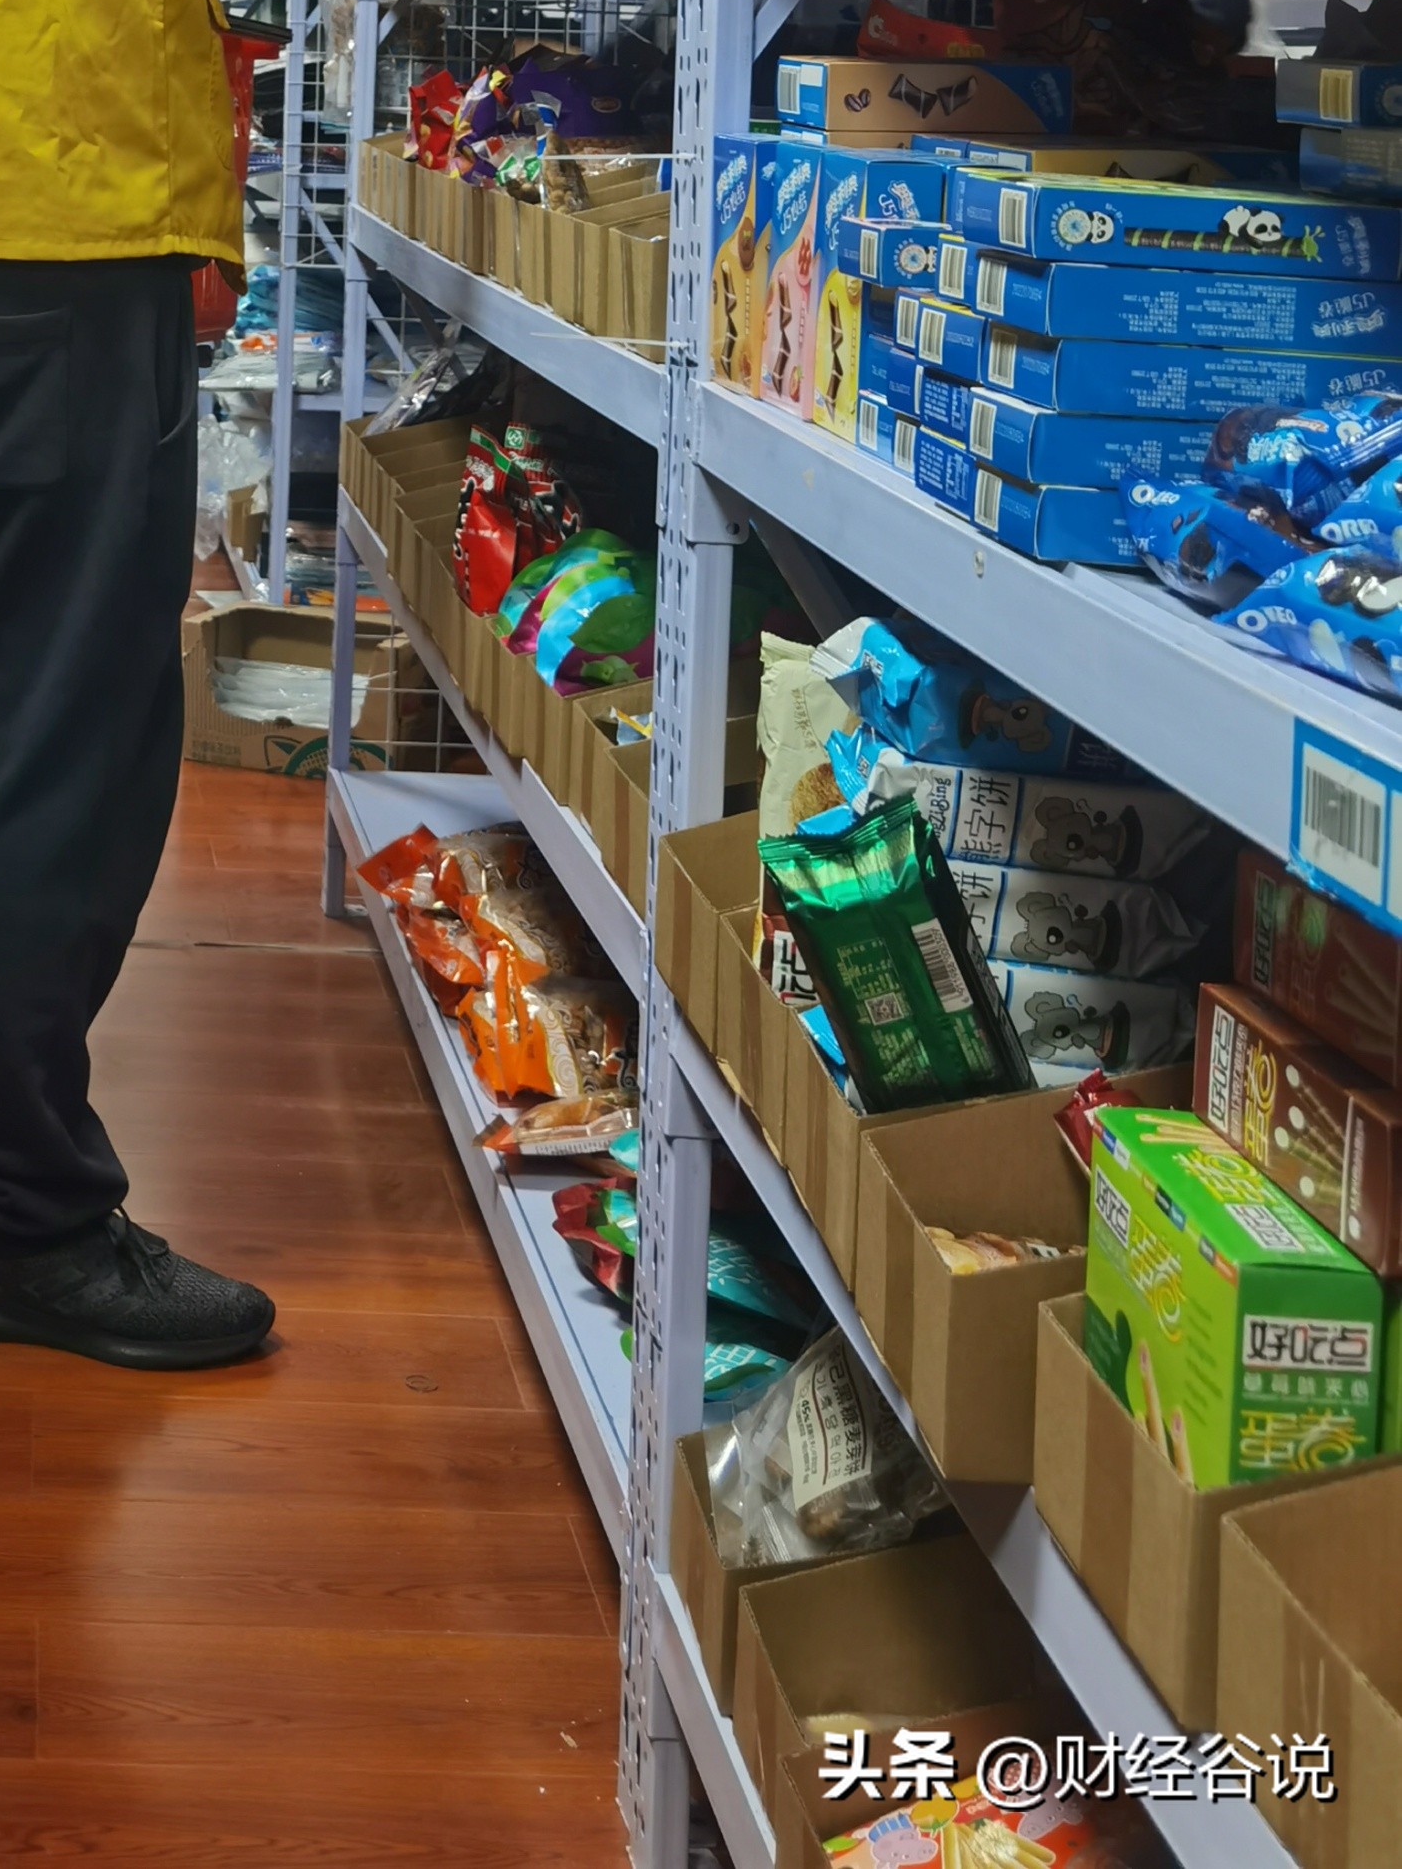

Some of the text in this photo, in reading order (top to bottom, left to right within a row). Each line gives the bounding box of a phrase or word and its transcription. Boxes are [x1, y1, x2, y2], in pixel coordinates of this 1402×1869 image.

[959, 775, 1012, 863] 熊字饼
[1248, 1320, 1368, 1367] 好吃点
